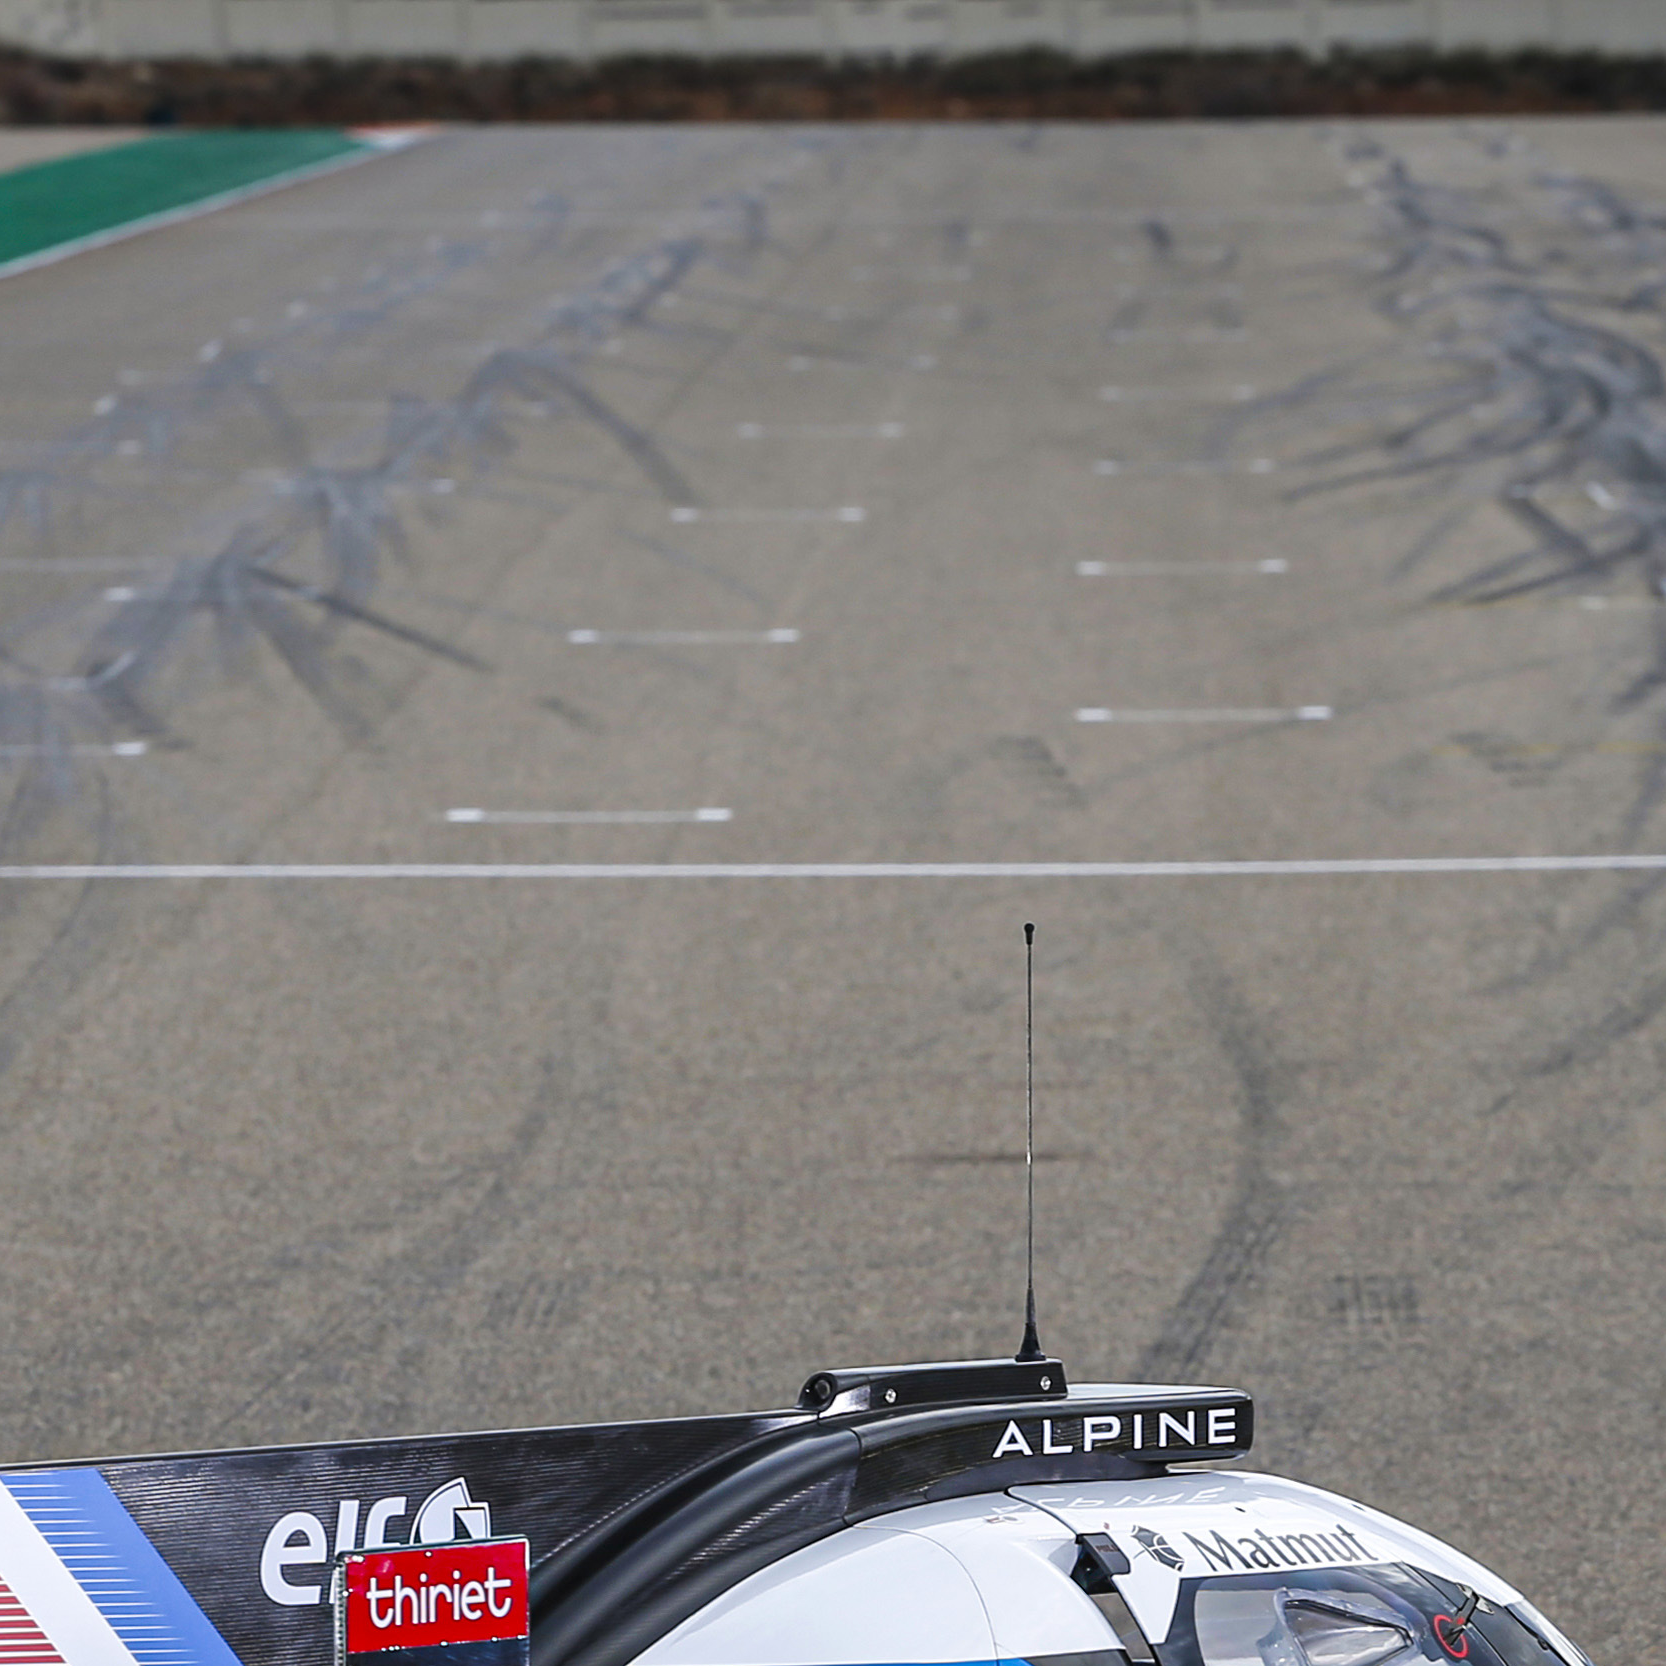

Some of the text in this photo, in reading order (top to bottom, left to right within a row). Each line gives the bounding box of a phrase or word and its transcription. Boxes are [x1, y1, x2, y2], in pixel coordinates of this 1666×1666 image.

[992, 1408, 1236, 1458] ALPINE
[1182, 1524, 1379, 1572] Matmut
[366, 1566, 513, 1629] thiriet
